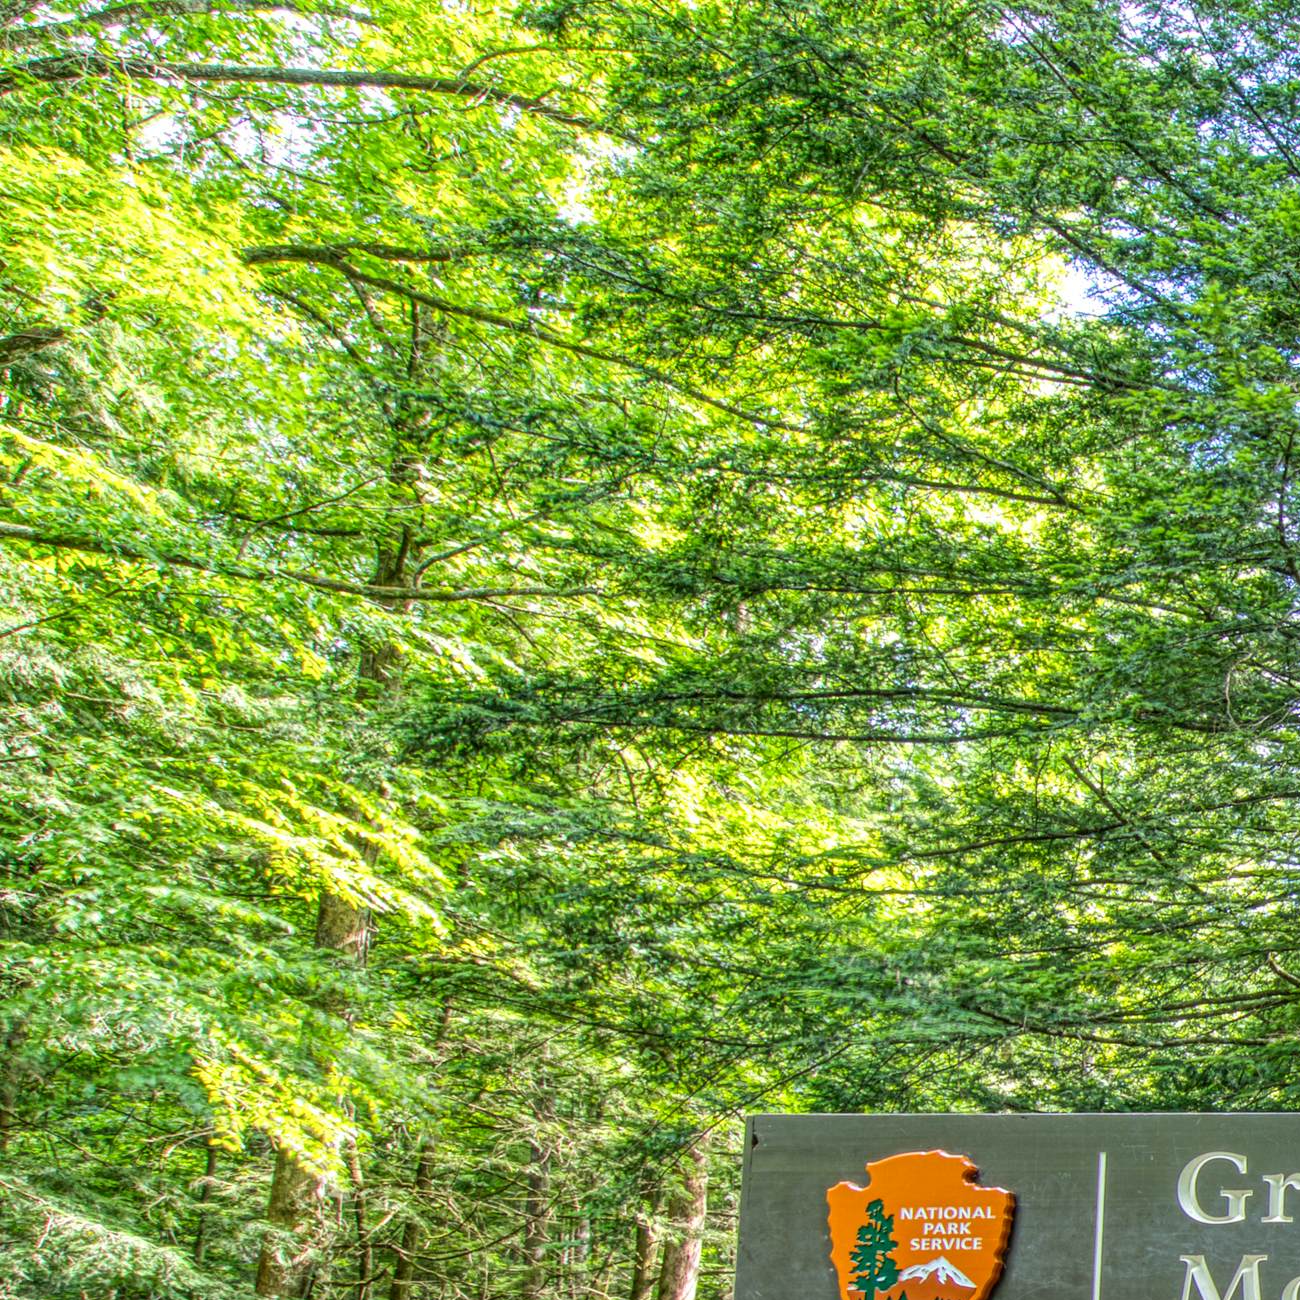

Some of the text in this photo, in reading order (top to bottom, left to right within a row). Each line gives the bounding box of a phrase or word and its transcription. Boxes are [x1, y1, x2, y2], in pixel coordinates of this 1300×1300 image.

[899, 1206, 996, 1220] NATIONAL
[922, 1222, 971, 1235] PARK
[910, 1237, 983, 1251] SERVICE
